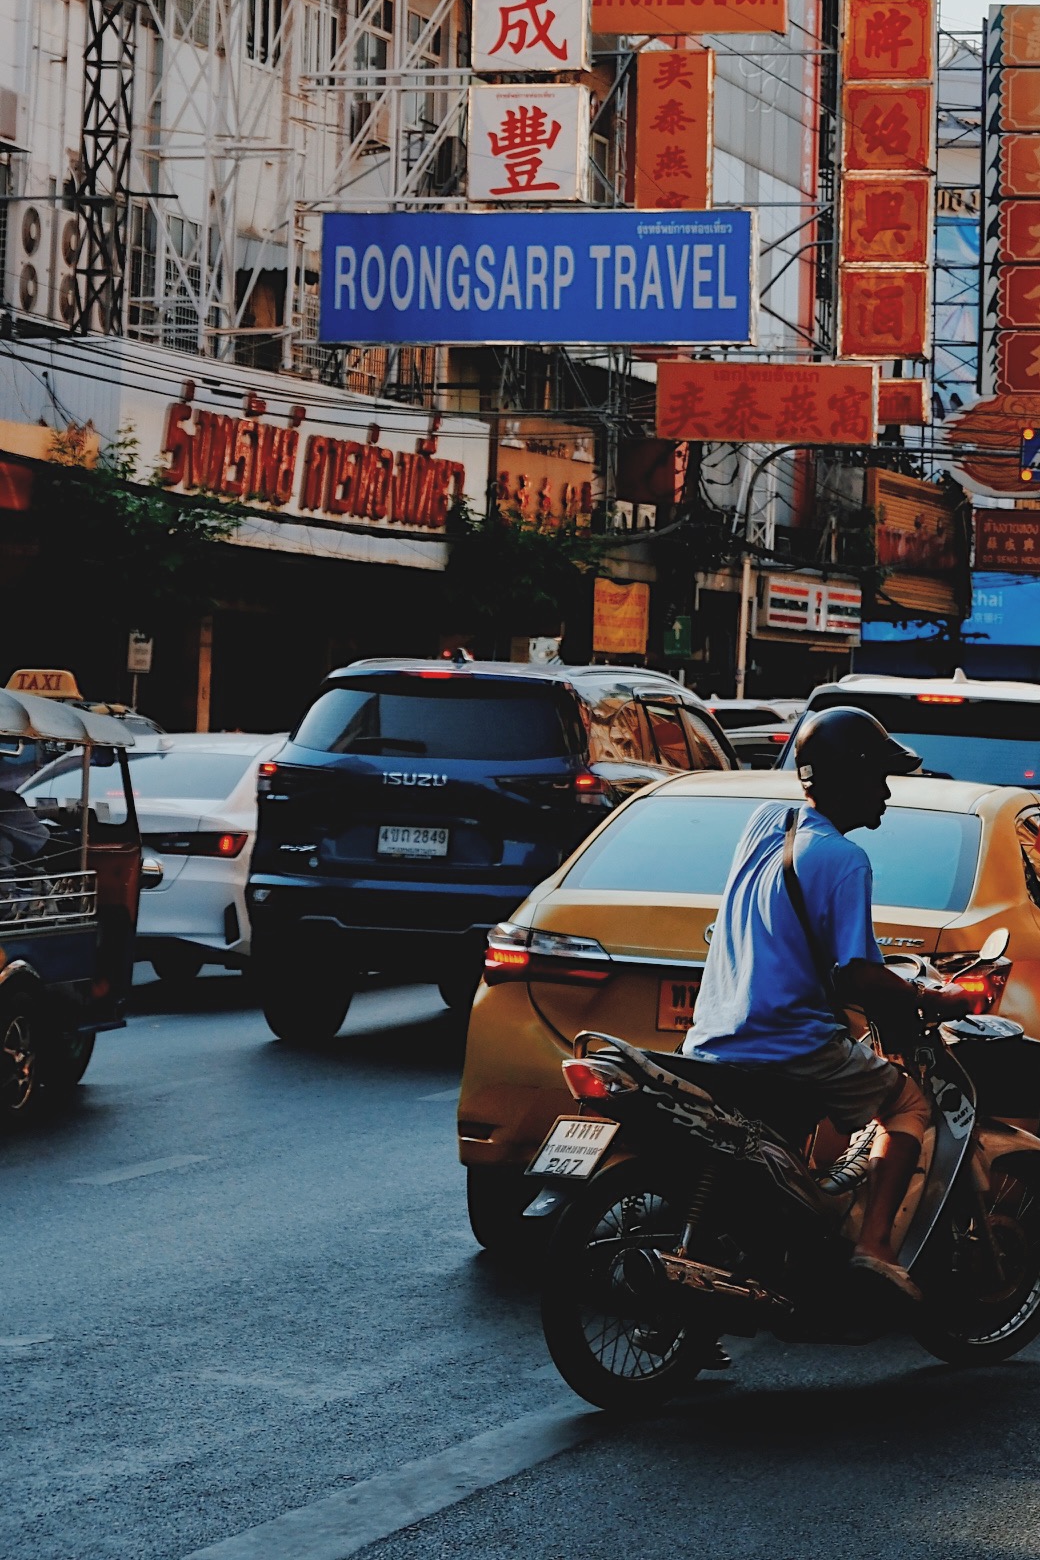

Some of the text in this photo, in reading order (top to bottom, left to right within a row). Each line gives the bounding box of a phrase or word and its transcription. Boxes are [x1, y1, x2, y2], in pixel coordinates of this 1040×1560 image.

[333, 244, 738, 311] ROONGSARP TRAVEL
[17, 673, 63, 690] TAXI
[382, 771, 448, 787] ISUZU
[413, 828, 447, 845] 2849
[876, 936, 925, 949] ALTIS
